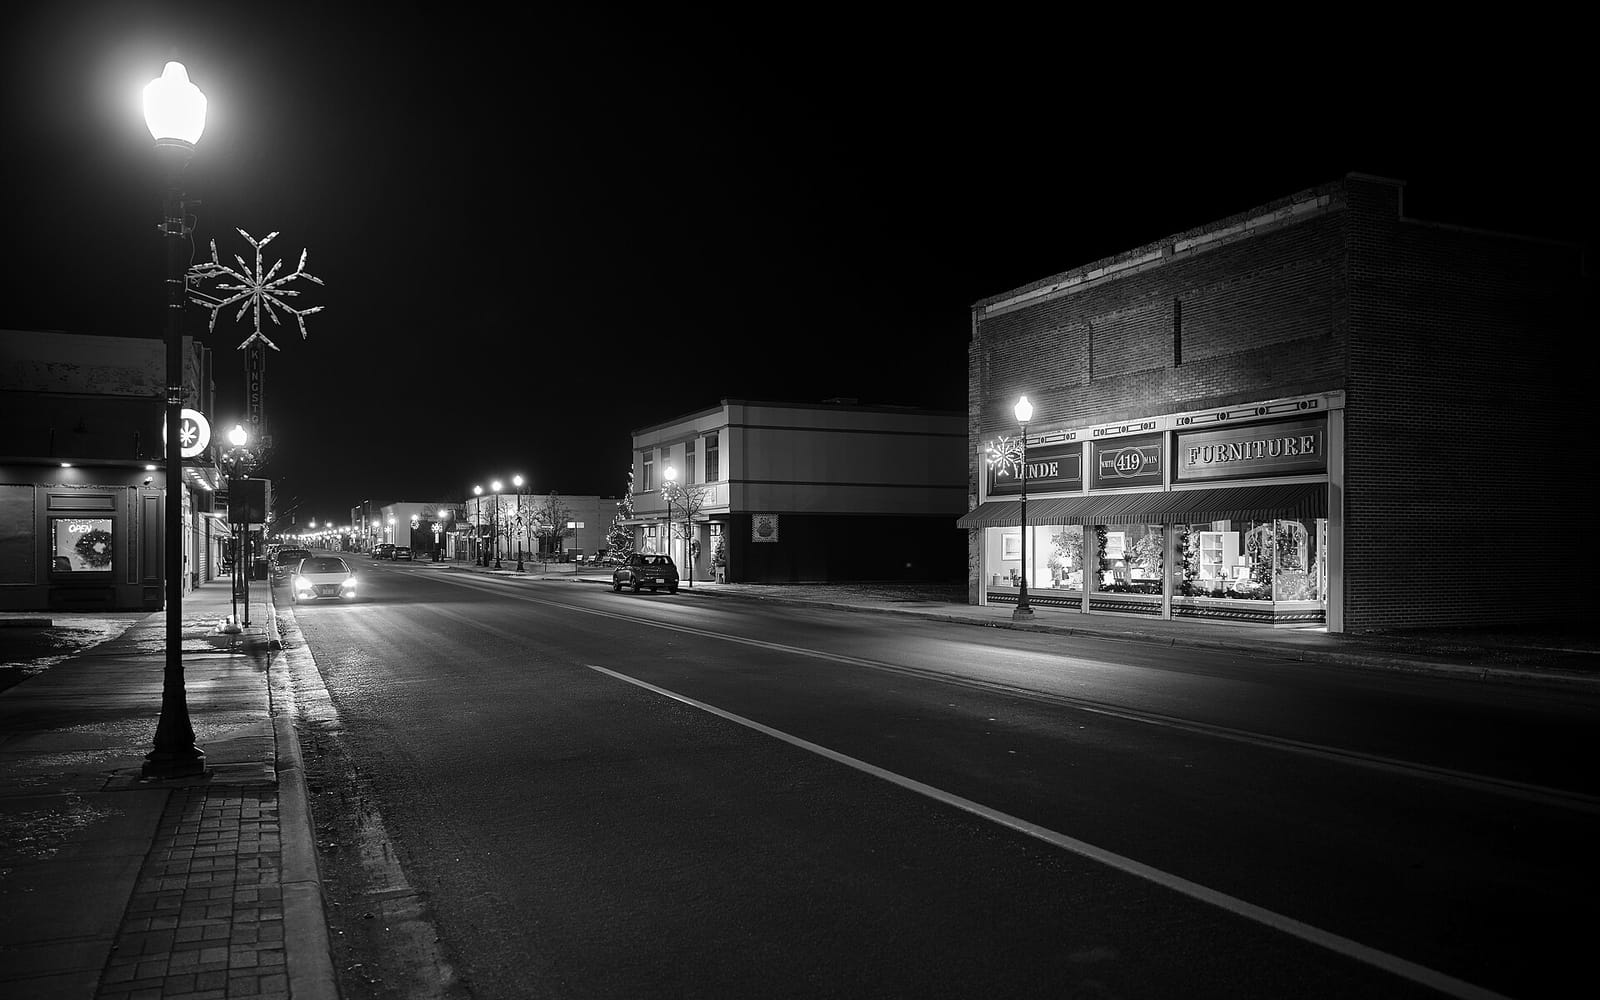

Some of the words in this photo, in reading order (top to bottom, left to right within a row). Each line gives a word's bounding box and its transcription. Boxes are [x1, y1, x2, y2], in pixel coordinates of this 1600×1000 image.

[1188, 434, 1315, 465] FURNITURE
[1116, 453, 1139, 471] 419
[69, 524, 92, 533] OPEN
